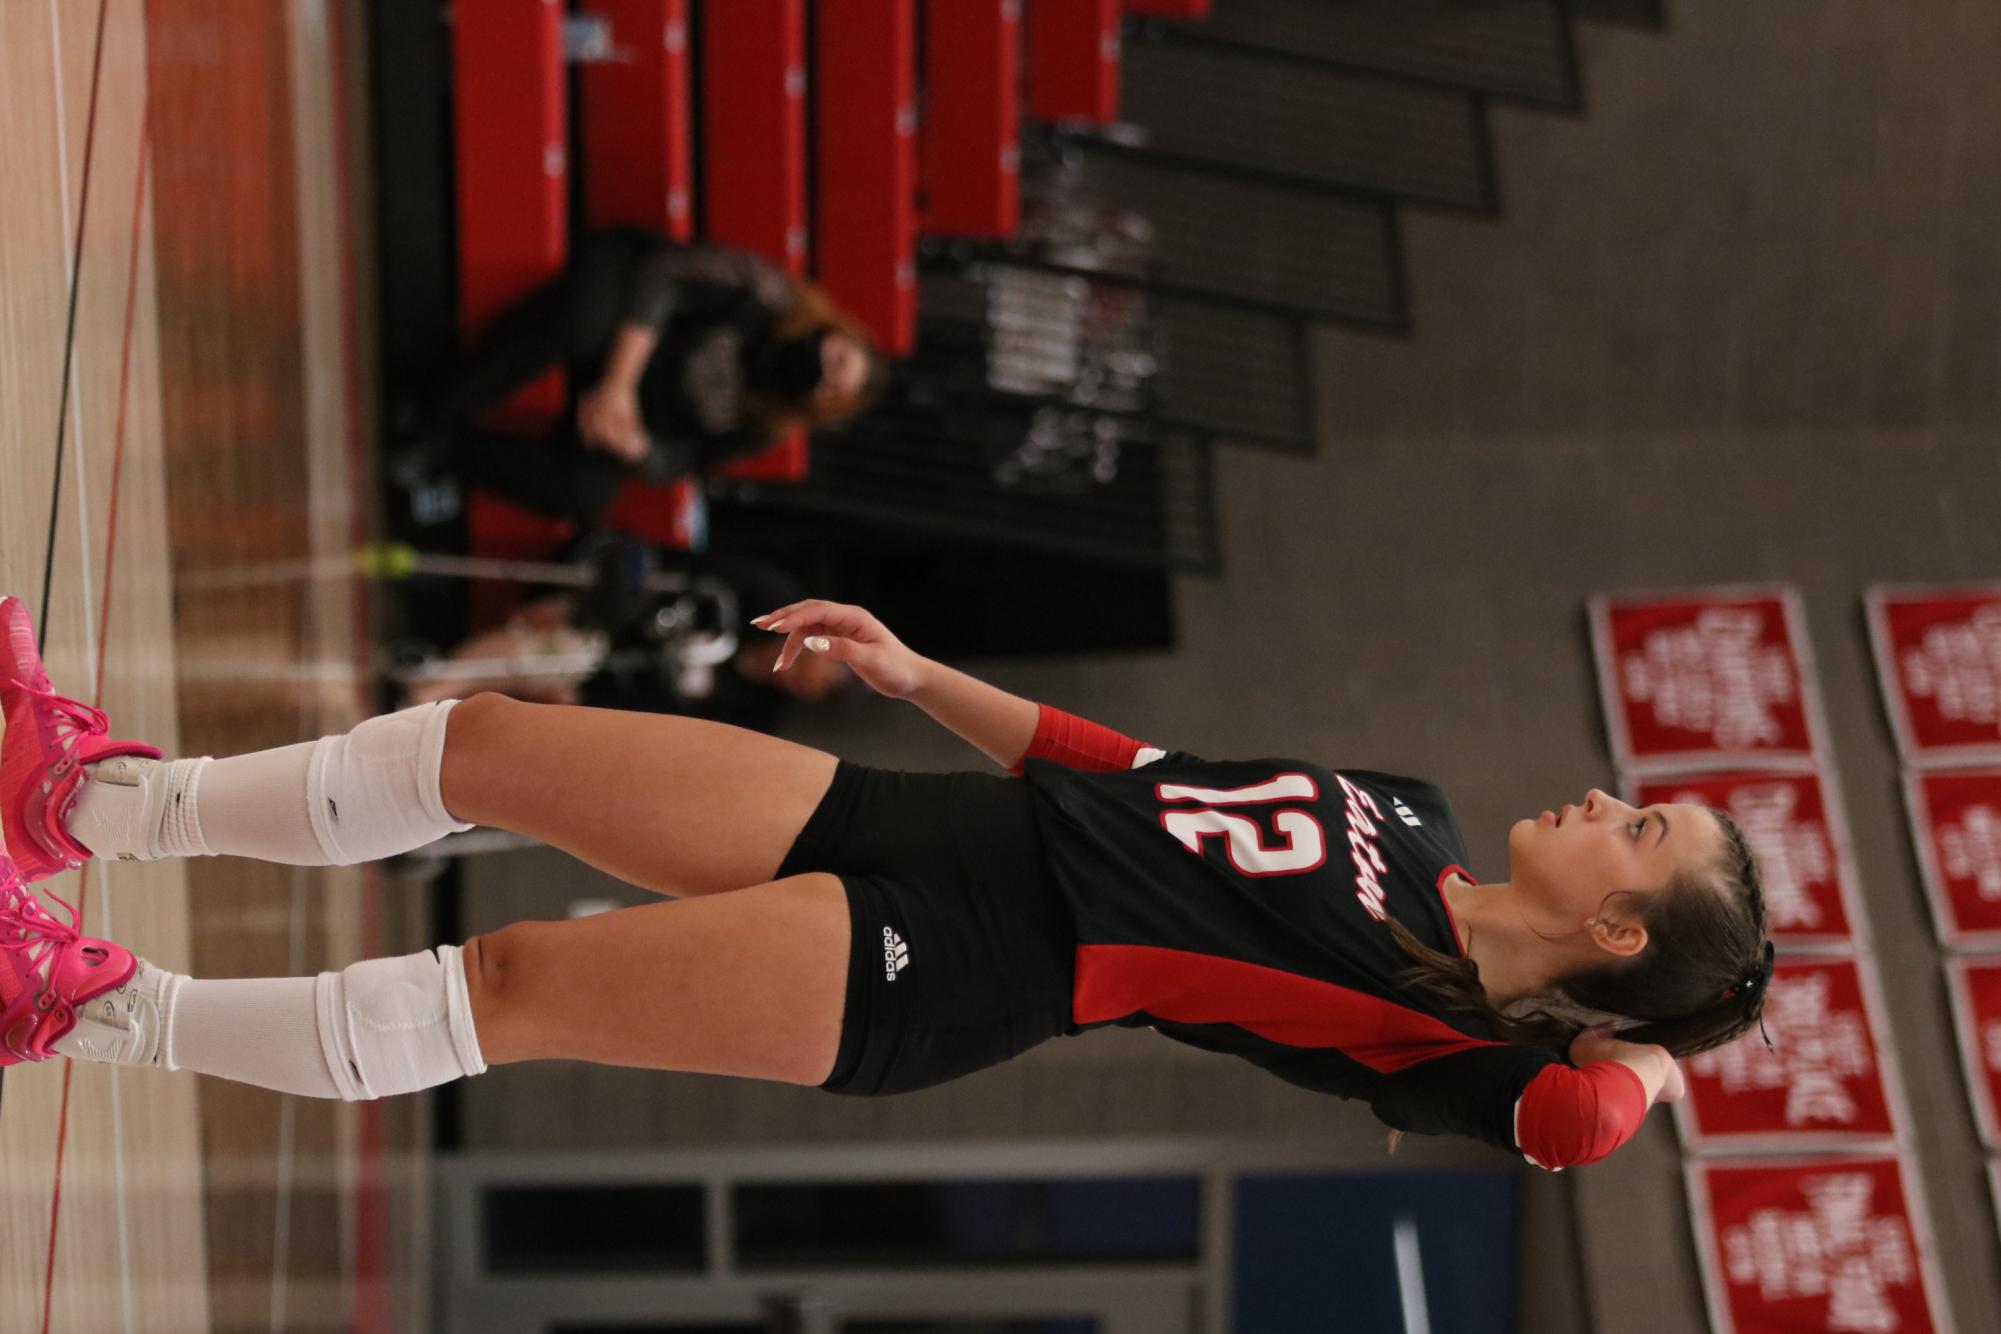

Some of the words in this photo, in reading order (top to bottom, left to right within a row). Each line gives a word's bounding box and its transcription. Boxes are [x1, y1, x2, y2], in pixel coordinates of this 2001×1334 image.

[1155, 772, 1326, 878] 12
[1335, 772, 1389, 922] Eaton
[883, 926, 897, 982] adidas
